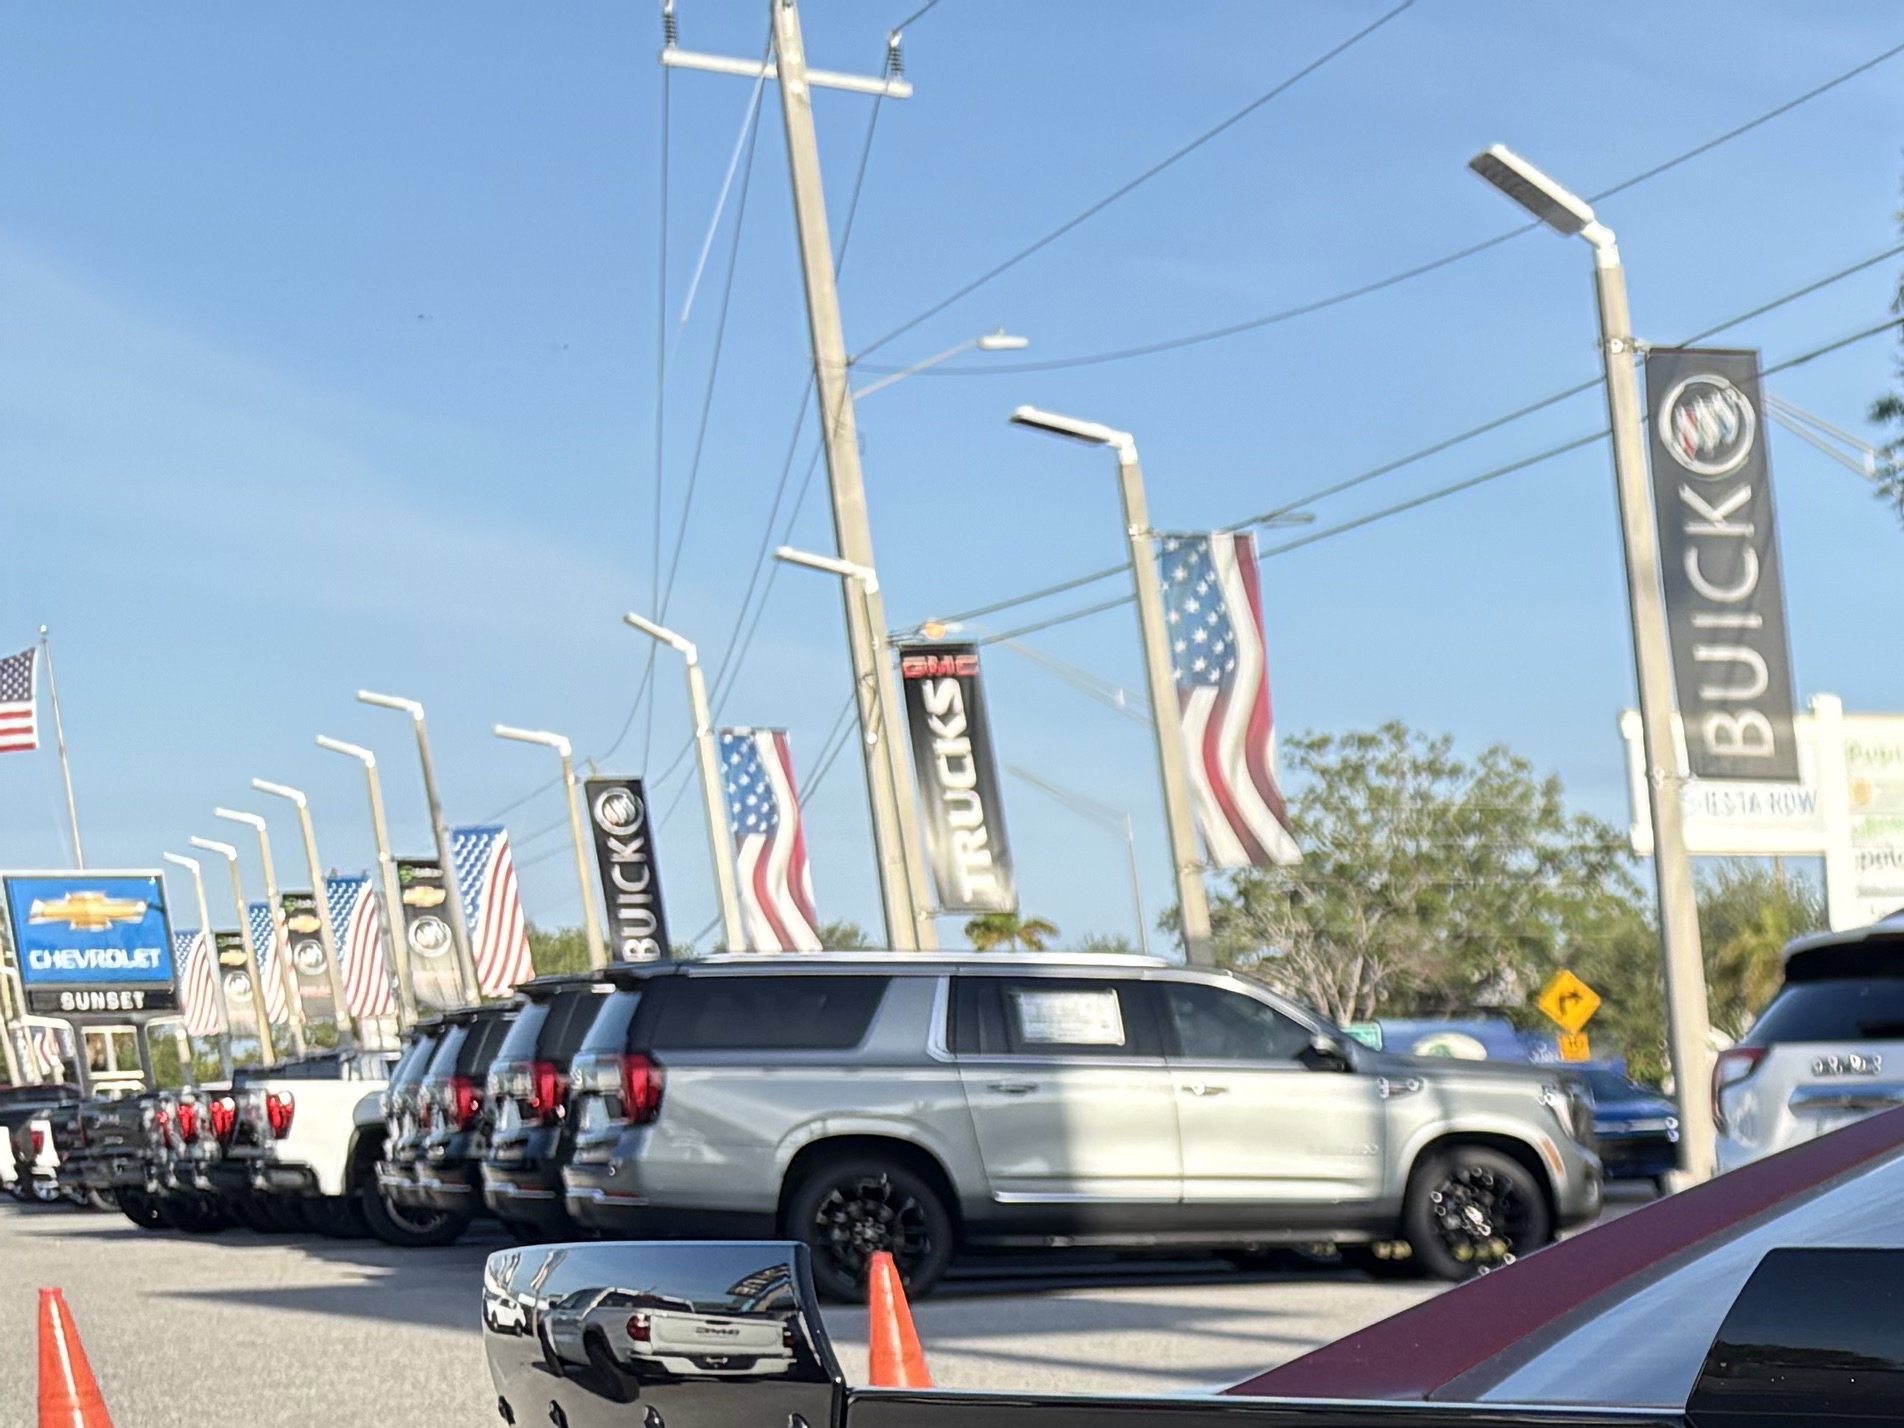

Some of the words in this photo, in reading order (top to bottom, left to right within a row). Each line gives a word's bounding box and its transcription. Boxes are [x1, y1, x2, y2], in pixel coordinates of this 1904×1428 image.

[1678, 483, 1776, 758] BUICK
[902, 655, 979, 679] GMC
[922, 677, 998, 903] TRUCKS
[607, 836, 661, 963] BUICK
[29, 948, 161, 970] CHEVROLET
[60, 991, 144, 1010] SUNSET
